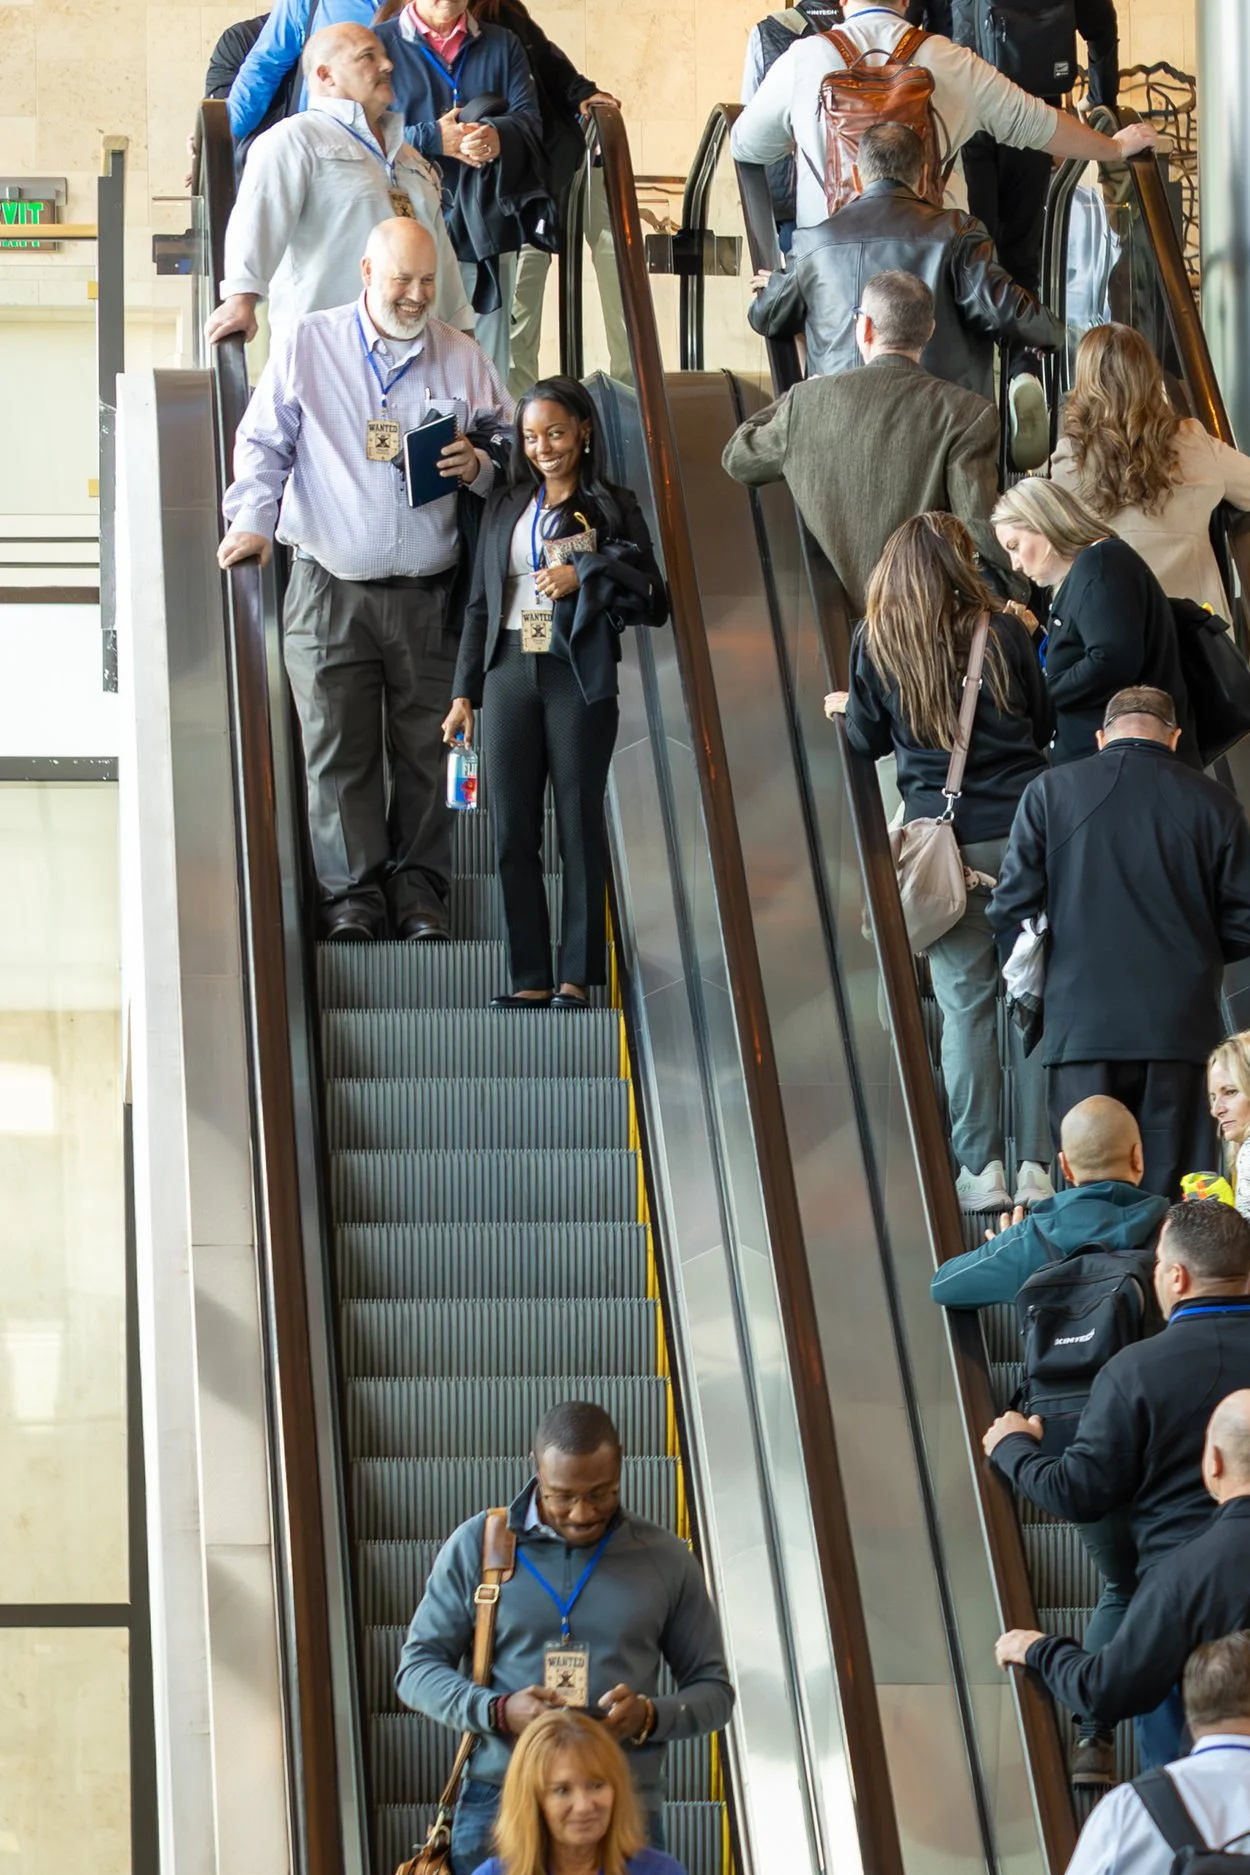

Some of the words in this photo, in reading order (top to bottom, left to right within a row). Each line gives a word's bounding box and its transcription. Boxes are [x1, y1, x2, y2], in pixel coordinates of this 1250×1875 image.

[0, 202, 44, 248] XIT
[368, 424, 398, 433] WANTED
[548, 1656, 585, 1668] WANTED
